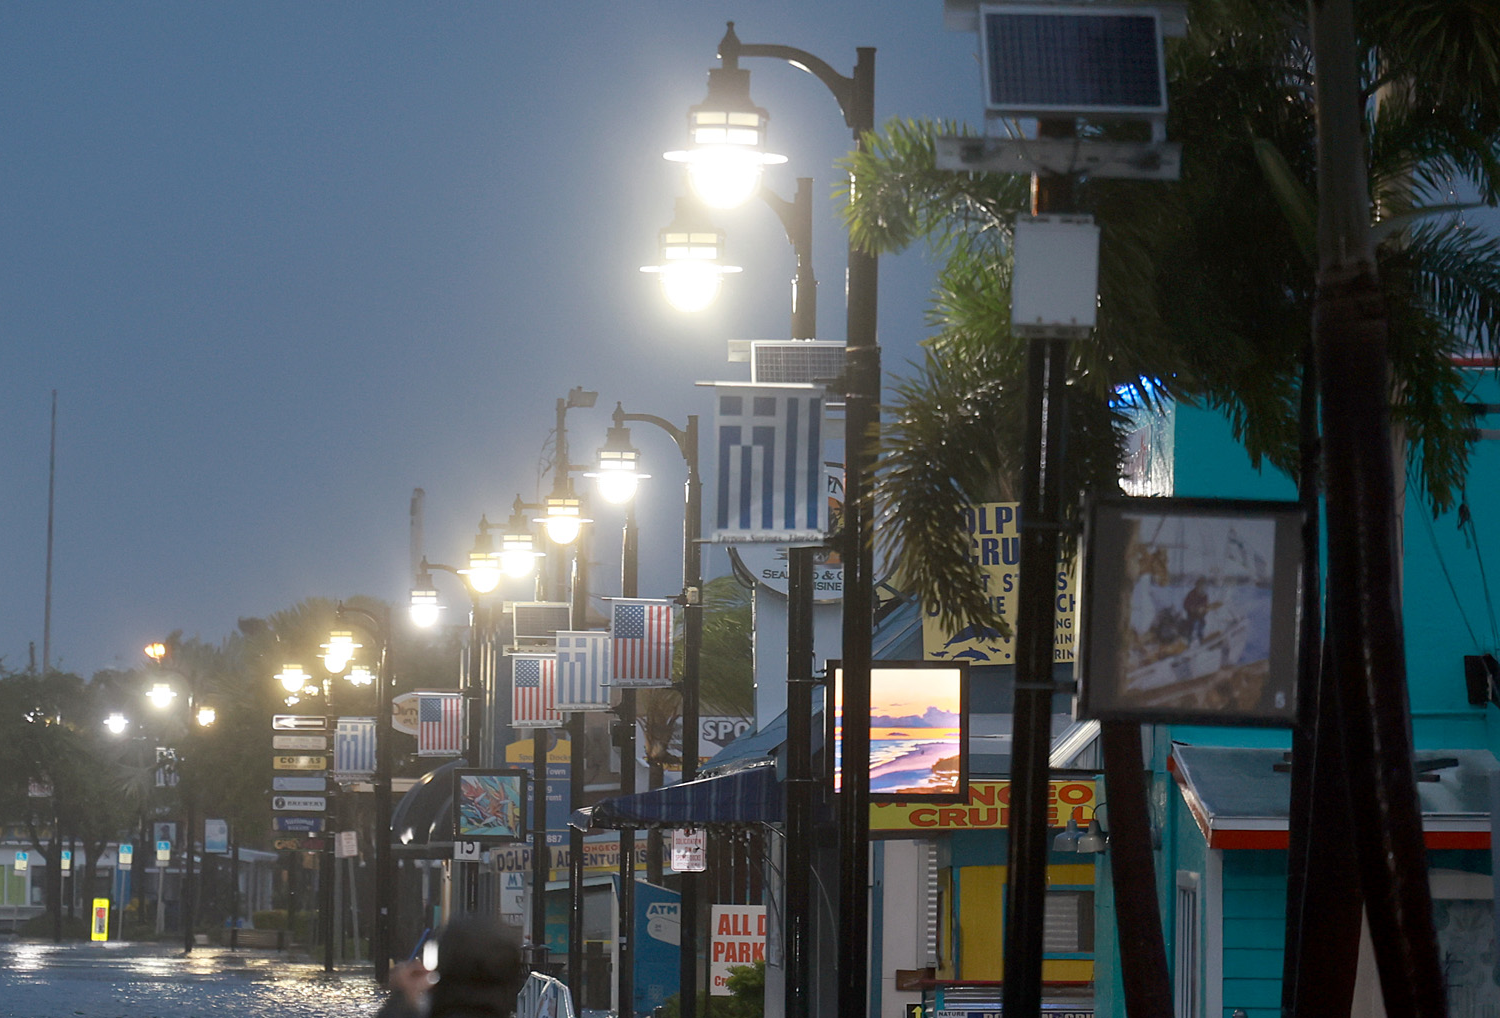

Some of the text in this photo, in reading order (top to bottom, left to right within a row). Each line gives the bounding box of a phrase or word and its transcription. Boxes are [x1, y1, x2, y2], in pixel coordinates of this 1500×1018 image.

[963, 538, 1020, 565] CRU
[822, 570, 835, 580] &
[813, 582, 842, 591] ISINE
[951, 776, 959, 788] 7
[650, 905, 678, 915] ATM
[718, 914, 752, 936] ALL
[713, 942, 765, 963] PARK
